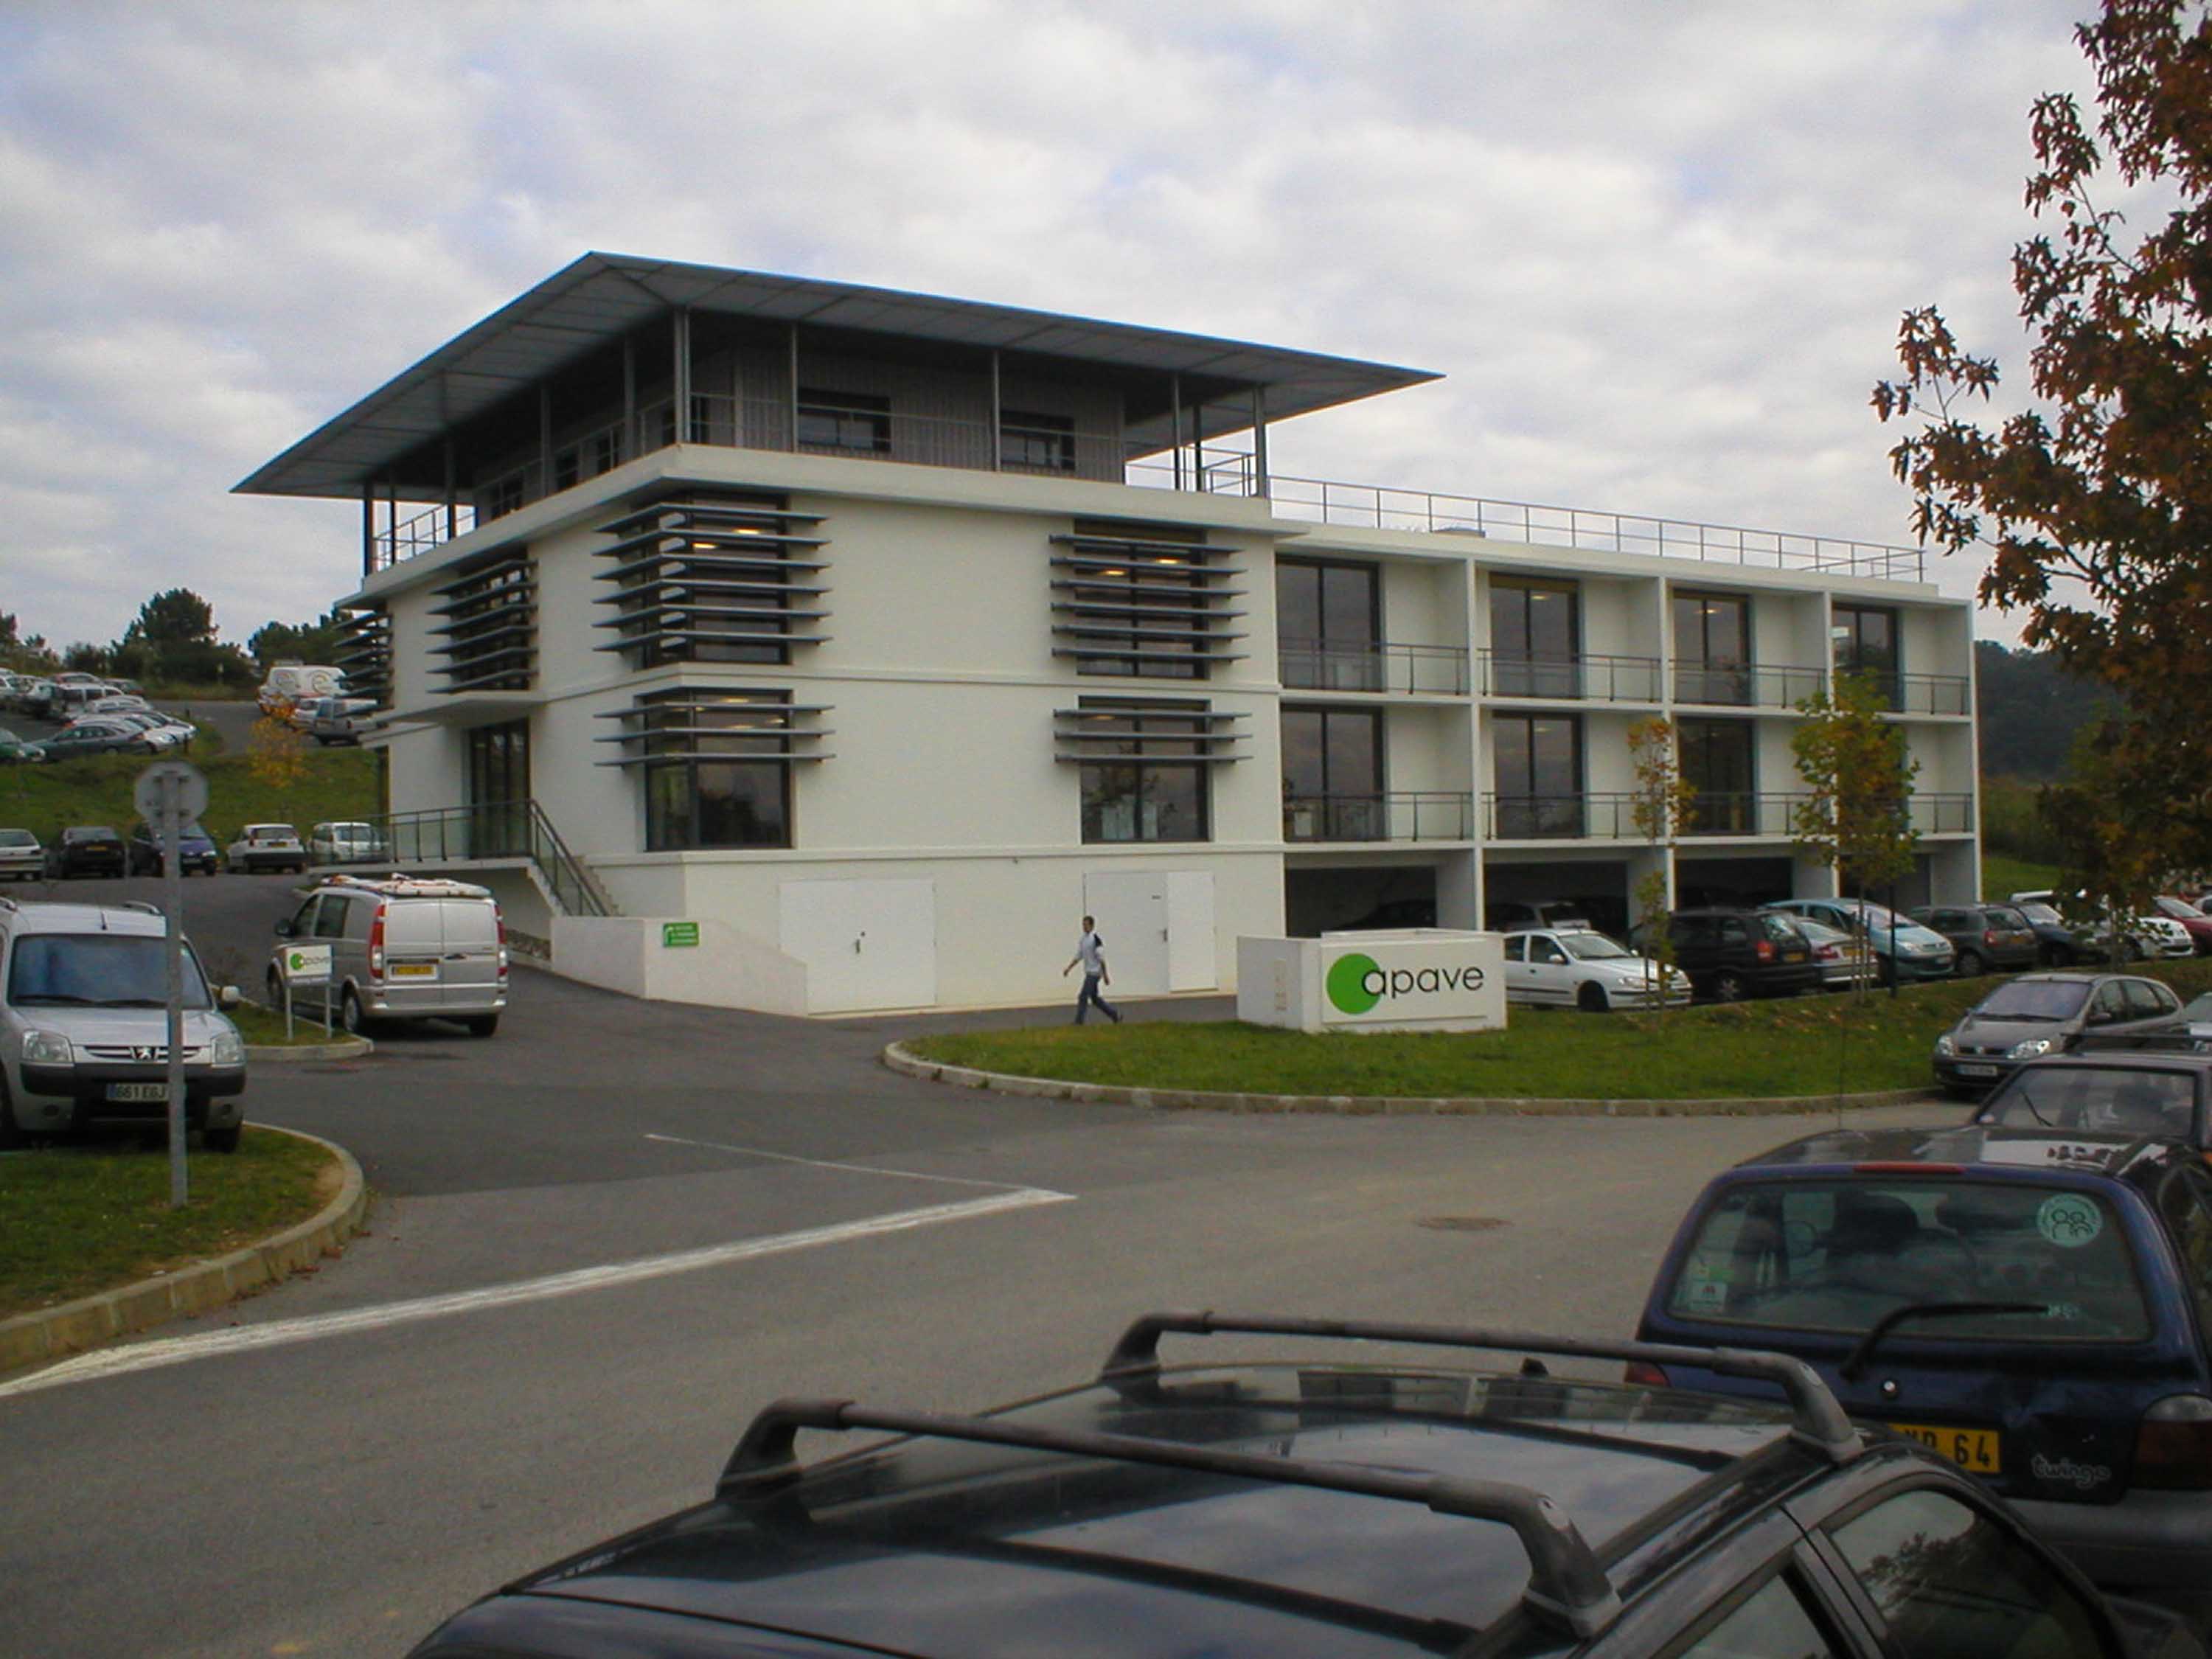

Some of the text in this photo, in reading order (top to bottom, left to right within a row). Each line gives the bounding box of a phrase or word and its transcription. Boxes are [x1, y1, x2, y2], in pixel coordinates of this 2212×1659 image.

[1361, 967, 1484, 998] apave
[1954, 1433, 1991, 1467] 64
[2031, 1453, 2112, 1488] twingo
